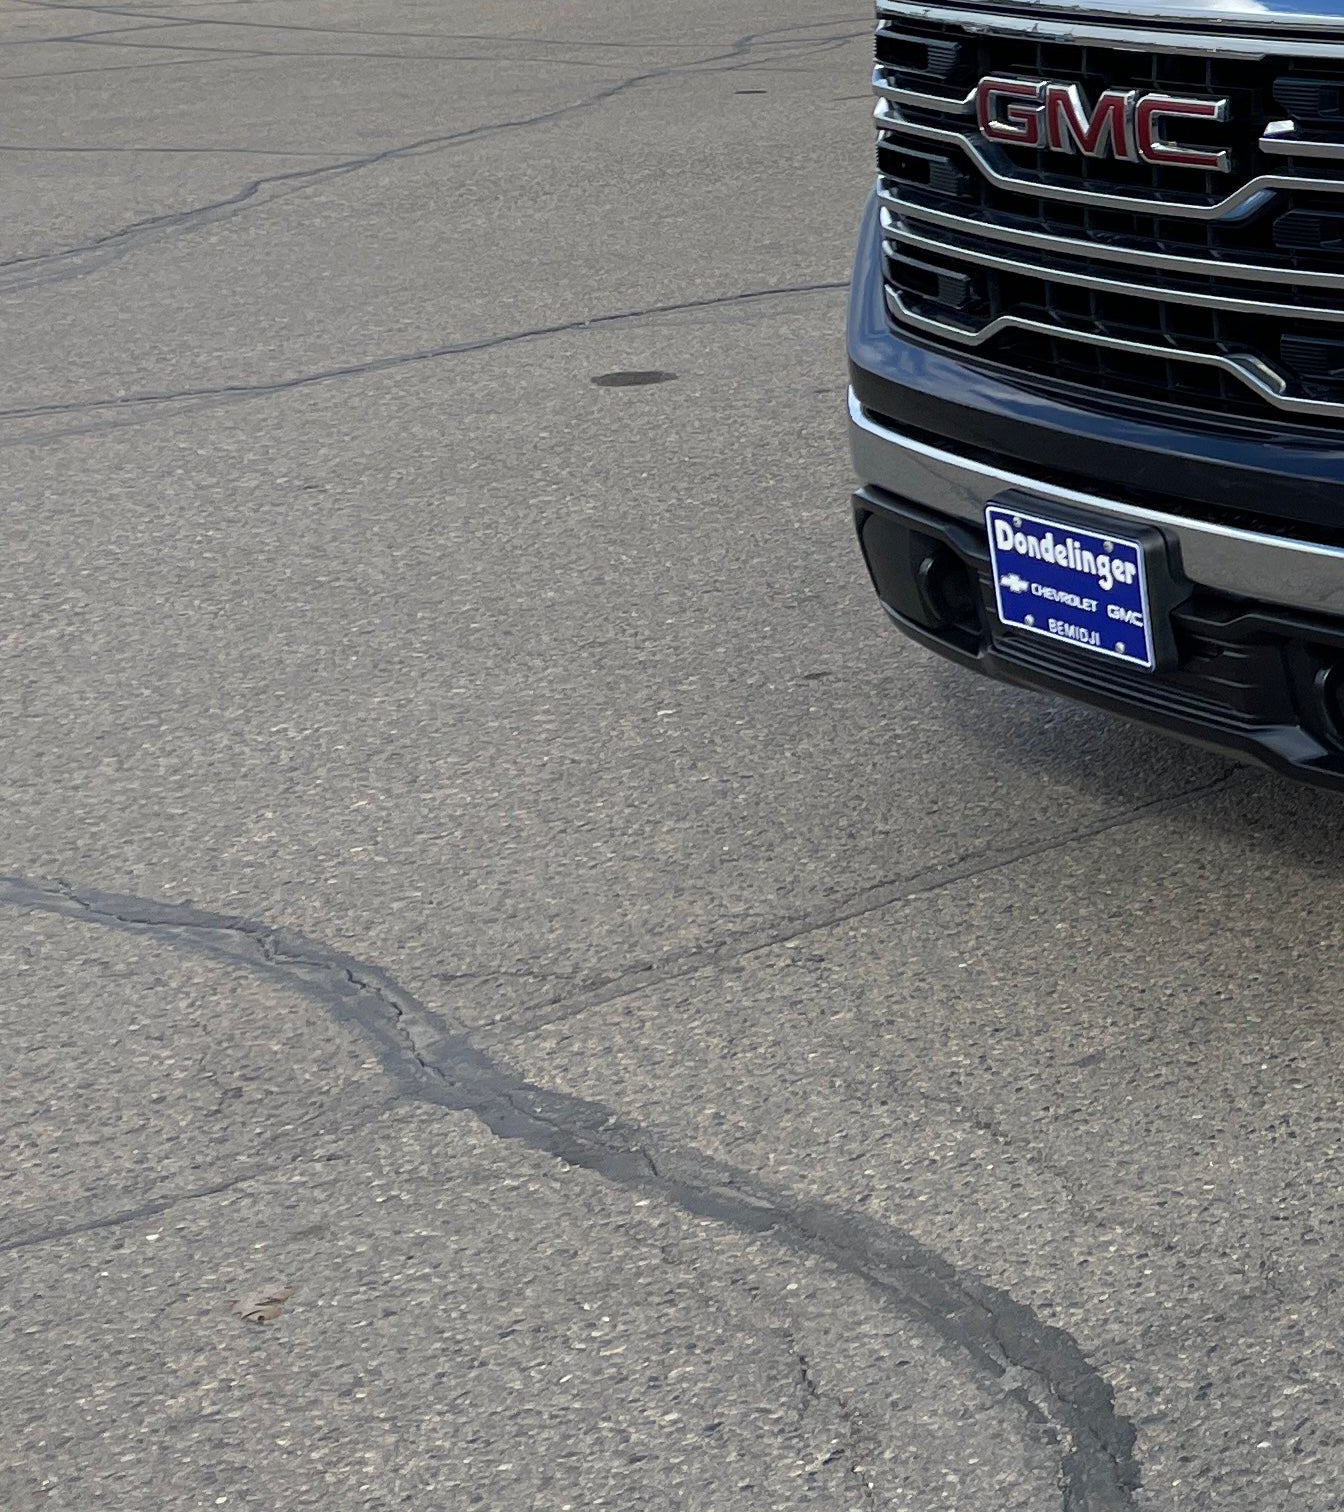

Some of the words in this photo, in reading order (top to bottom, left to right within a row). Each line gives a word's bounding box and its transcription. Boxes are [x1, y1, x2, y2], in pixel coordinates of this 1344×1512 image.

[977, 76, 1232, 173] GMC
[994, 518, 1137, 591] Dondelinger
[1031, 582, 1099, 613] CHEVROLET
[1107, 603, 1144, 628] GMC
[1048, 617, 1101, 647] BEMIDJI
